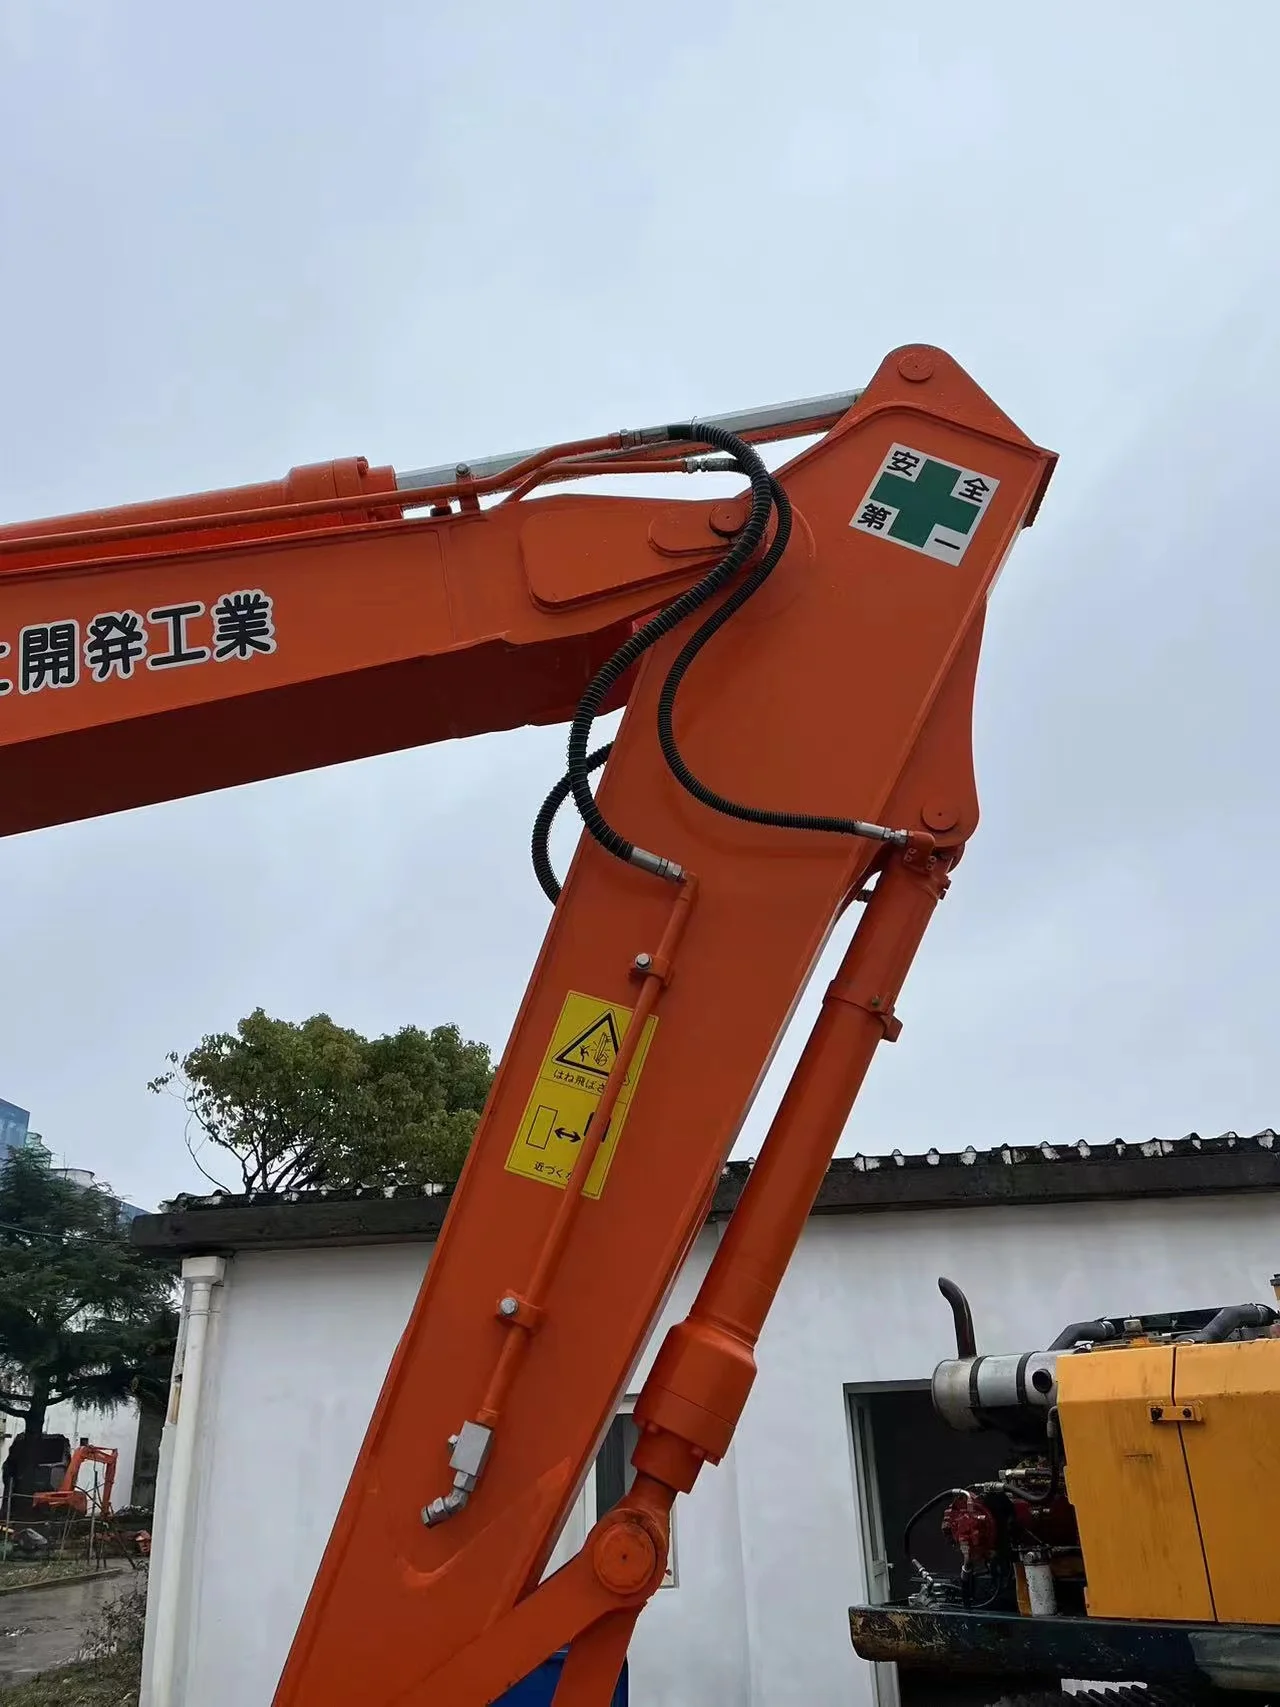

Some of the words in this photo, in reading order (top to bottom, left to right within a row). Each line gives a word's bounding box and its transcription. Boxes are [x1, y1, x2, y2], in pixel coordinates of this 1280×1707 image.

[886, 449, 921, 477] 安
[958, 477, 990, 503] 全
[857, 502, 892, 531] 第
[0, 589, 277, 695] 開発工業
